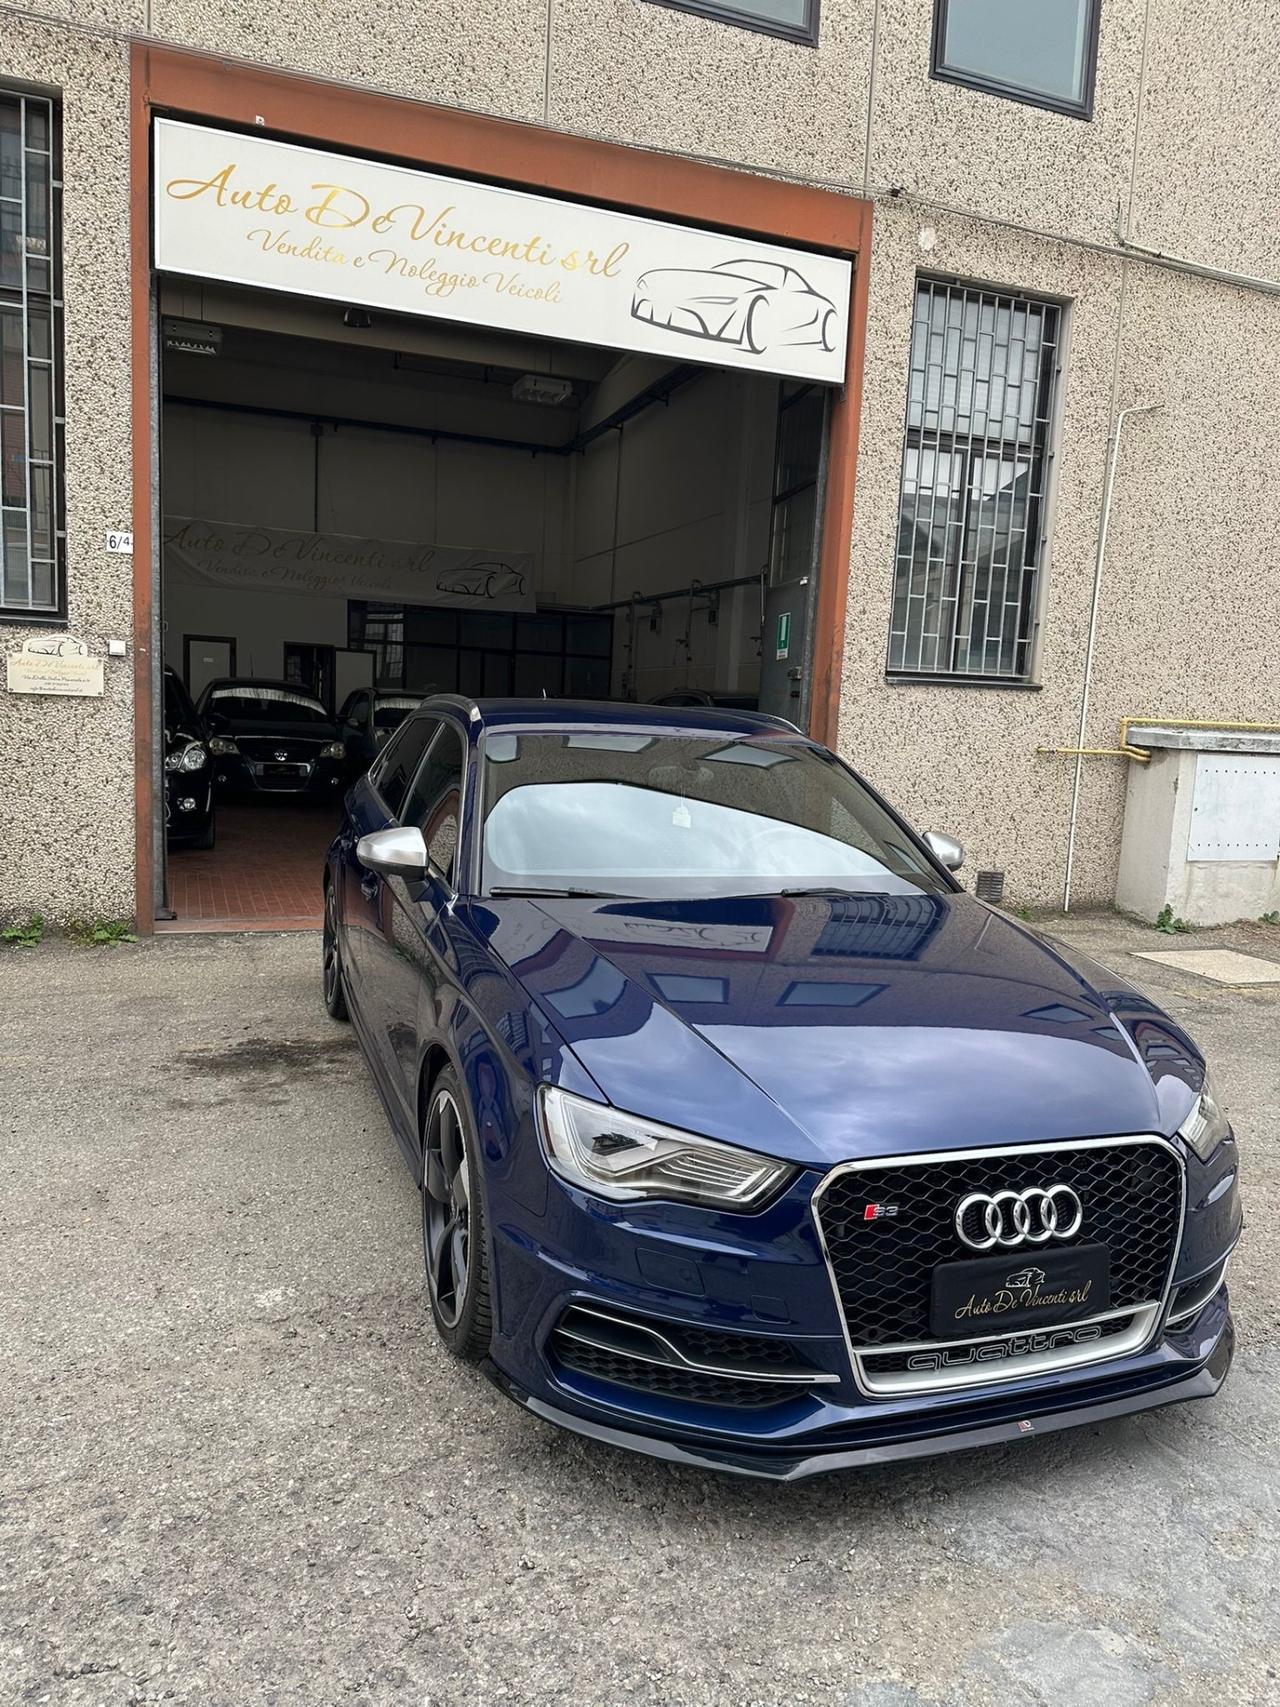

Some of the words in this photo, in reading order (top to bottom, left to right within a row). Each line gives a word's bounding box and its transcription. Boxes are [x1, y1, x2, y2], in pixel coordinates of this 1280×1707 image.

[166, 164, 297, 215] Auto
[304, 183, 394, 234] De
[385, 204, 557, 267] Vincenti
[560, 242, 630, 278] srl
[246, 228, 347, 266] Vendita
[353, 253, 366, 269] e
[367, 250, 480, 298] Noleggio
[482, 271, 563, 304] Veicoli
[954, 1294, 992, 1319] Auto
[993, 1290, 1017, 1313] De
[1019, 1284, 1068, 1308] Vincenti
[1068, 1280, 1092, 1303] srl
[908, 1325, 1102, 1372] quattro
